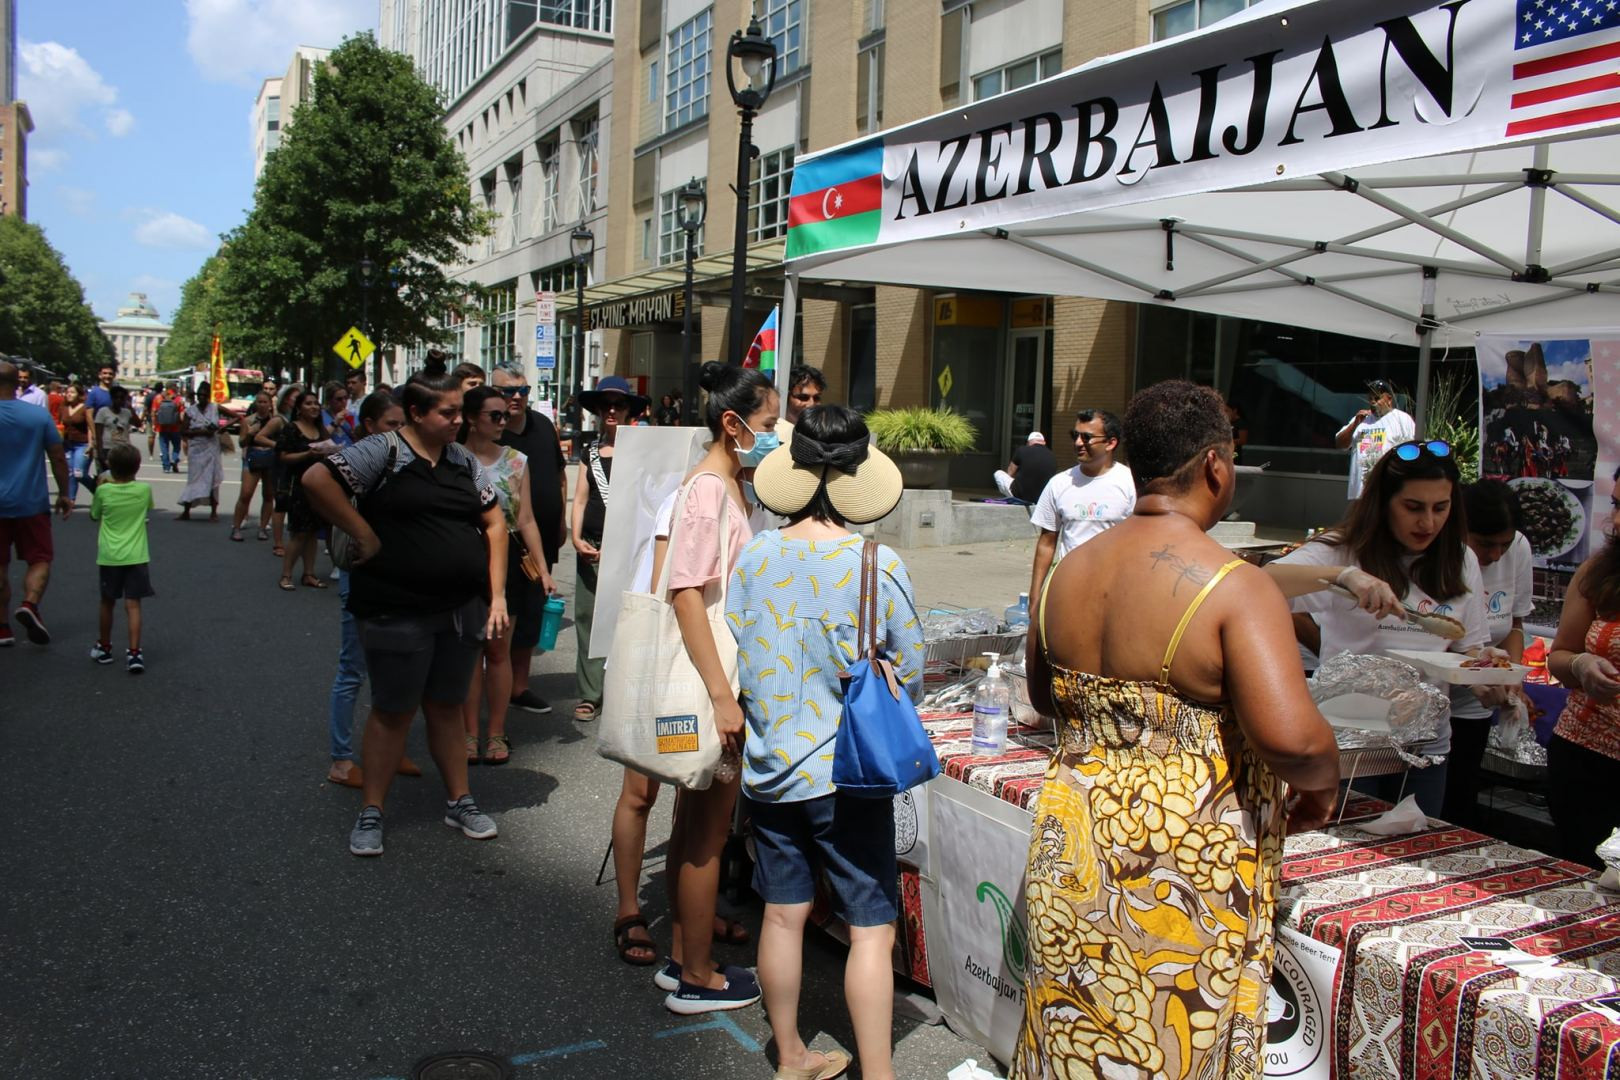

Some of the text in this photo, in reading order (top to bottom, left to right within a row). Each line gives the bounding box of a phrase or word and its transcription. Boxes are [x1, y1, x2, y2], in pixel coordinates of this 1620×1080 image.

[895, 0, 1471, 220] AZERBAIJAN
[590, 303, 626, 330] FLYING
[629, 293, 672, 325] MAYAN
[537, 327, 543, 338] 2
[657, 720, 695, 736] IMITREX
[1300, 942, 1317, 956] Beer
[1319, 950, 1336, 964] Tent
[965, 954, 1017, 1003] Azerbaijan
[1274, 949, 1317, 1047] NCOURAGED
